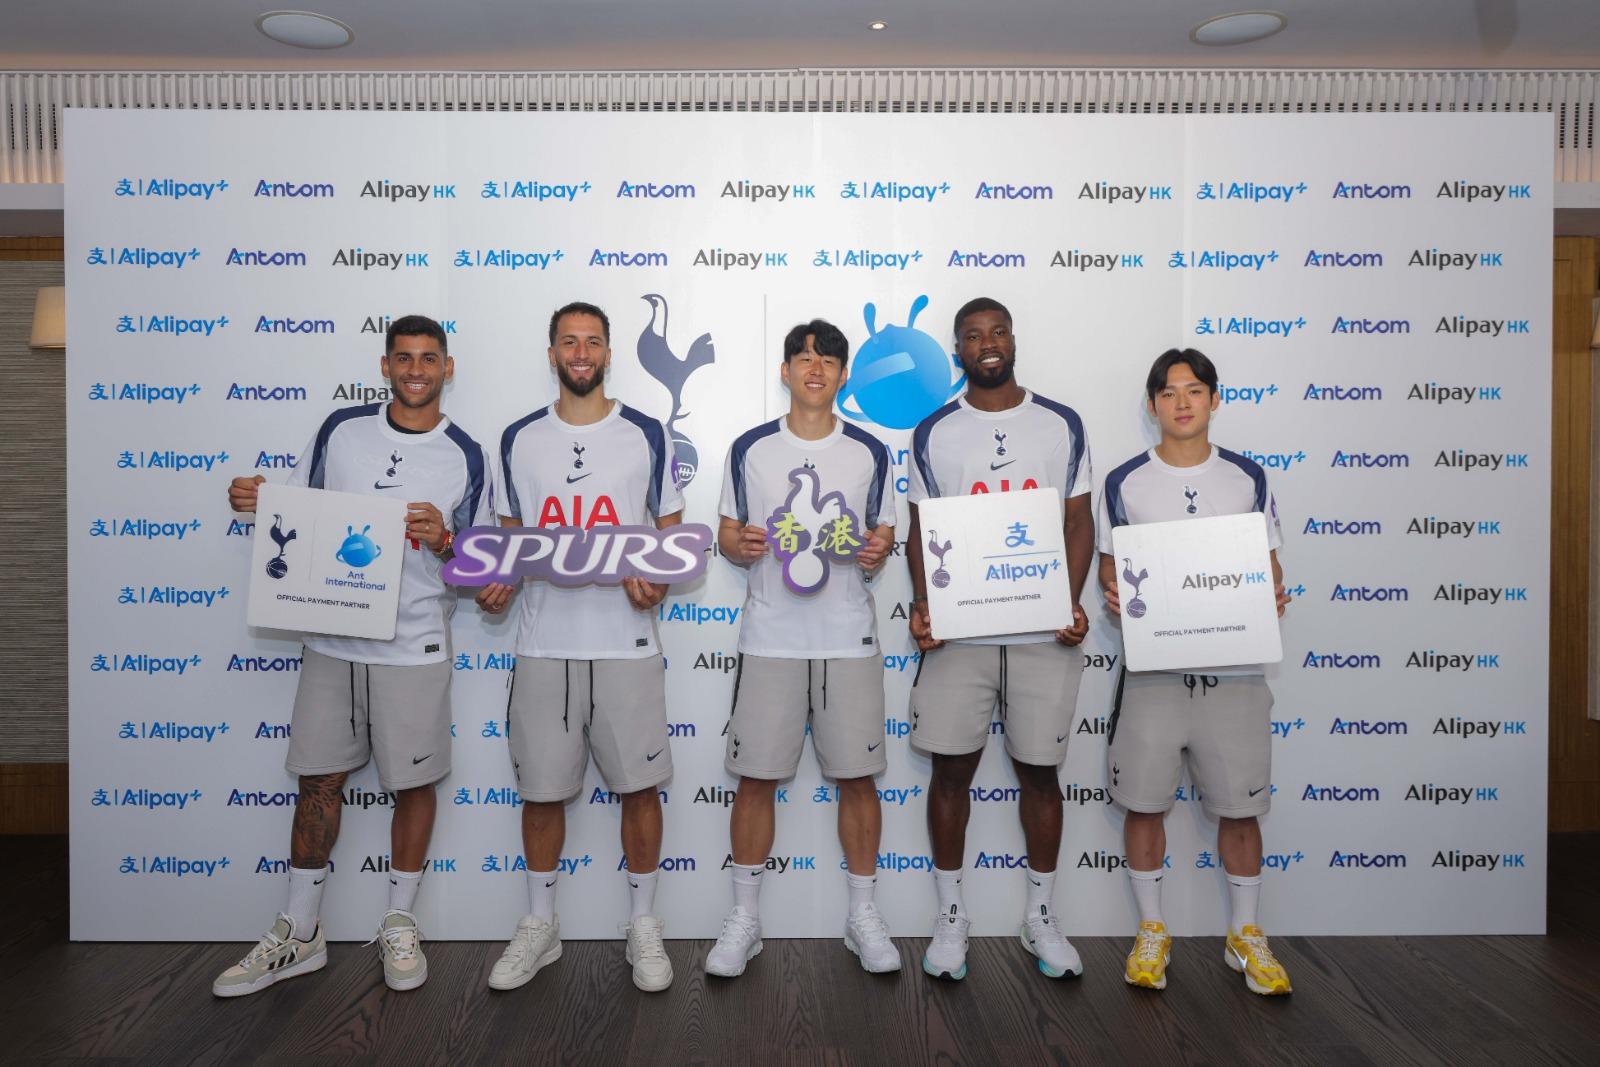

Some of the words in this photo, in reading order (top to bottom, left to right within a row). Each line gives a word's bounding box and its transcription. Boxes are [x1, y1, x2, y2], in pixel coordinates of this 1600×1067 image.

[146, 178, 229, 200] Alipay+
[254, 180, 334, 197] Antom
[511, 180, 592, 202] Alipay+
[617, 180, 695, 198] Antom
[870, 181, 951, 203] Alipay+
[975, 182, 1053, 199] Antom
[1226, 182, 1308, 204] Alipay+
[1332, 181, 1410, 199] Antom
[115, 248, 200, 268] Alipay+
[226, 248, 306, 266] Antom
[483, 249, 565, 270] Alipay+
[589, 249, 668, 267] Antom
[843, 250, 923, 272] Alipay+
[947, 250, 1025, 267] Antom
[1197, 250, 1279, 272] Alipay+
[1304, 250, 1383, 267] Antom
[147, 315, 229, 336] Alipay+
[255, 315, 334, 333] Antom
[1225, 316, 1307, 337] Alipay+
[1331, 316, 1410, 333] Antom
[119, 383, 201, 404] Alipay+
[226, 383, 306, 400] Antom
[332, 382, 393, 404] Alipa
[1303, 384, 1382, 400] Antom
[147, 450, 230, 472] Alipay+
[255, 451, 298, 468] Ant
[1331, 450, 1409, 468] Antom
[538, 495, 620, 529] AIA
[120, 518, 201, 540] Alipay+
[773, 512, 862, 555] 香港
[1005, 522, 1034, 548] 支
[1303, 518, 1381, 535] Antom
[452, 532, 702, 577] SPURS
[347, 571, 364, 580] Ant
[986, 559, 1061, 582] Alipay+
[325, 577, 386, 592] International
[1330, 584, 1408, 601] Antom
[148, 586, 230, 608] Alipay+
[276, 594, 307, 604] OFFICIAL
[307, 597, 340, 606] PAYMENT
[341, 601, 370, 610] PARTNER
[957, 598, 985, 607] OFFICIAL
[985, 596, 1014, 605] PAYMENT
[1014, 593, 1042, 602] PARTNER
[668, 603, 742, 625] Alipay
[1153, 629, 1183, 638] OFFICIAL
[1184, 627, 1215, 636] PAYMENT
[1216, 625, 1246, 634] PARTNER
[121, 655, 202, 675] Alipay+
[693, 652, 736, 673] Alip
[1303, 651, 1380, 668] Antom
[149, 720, 230, 743] Alipay+
[1330, 718, 1407, 735] Antom
[121, 789, 202, 809] Alipay+
[1302, 784, 1379, 801] Antom
[149, 856, 230, 879] Alipay+
[1329, 851, 1406, 868] Antom
